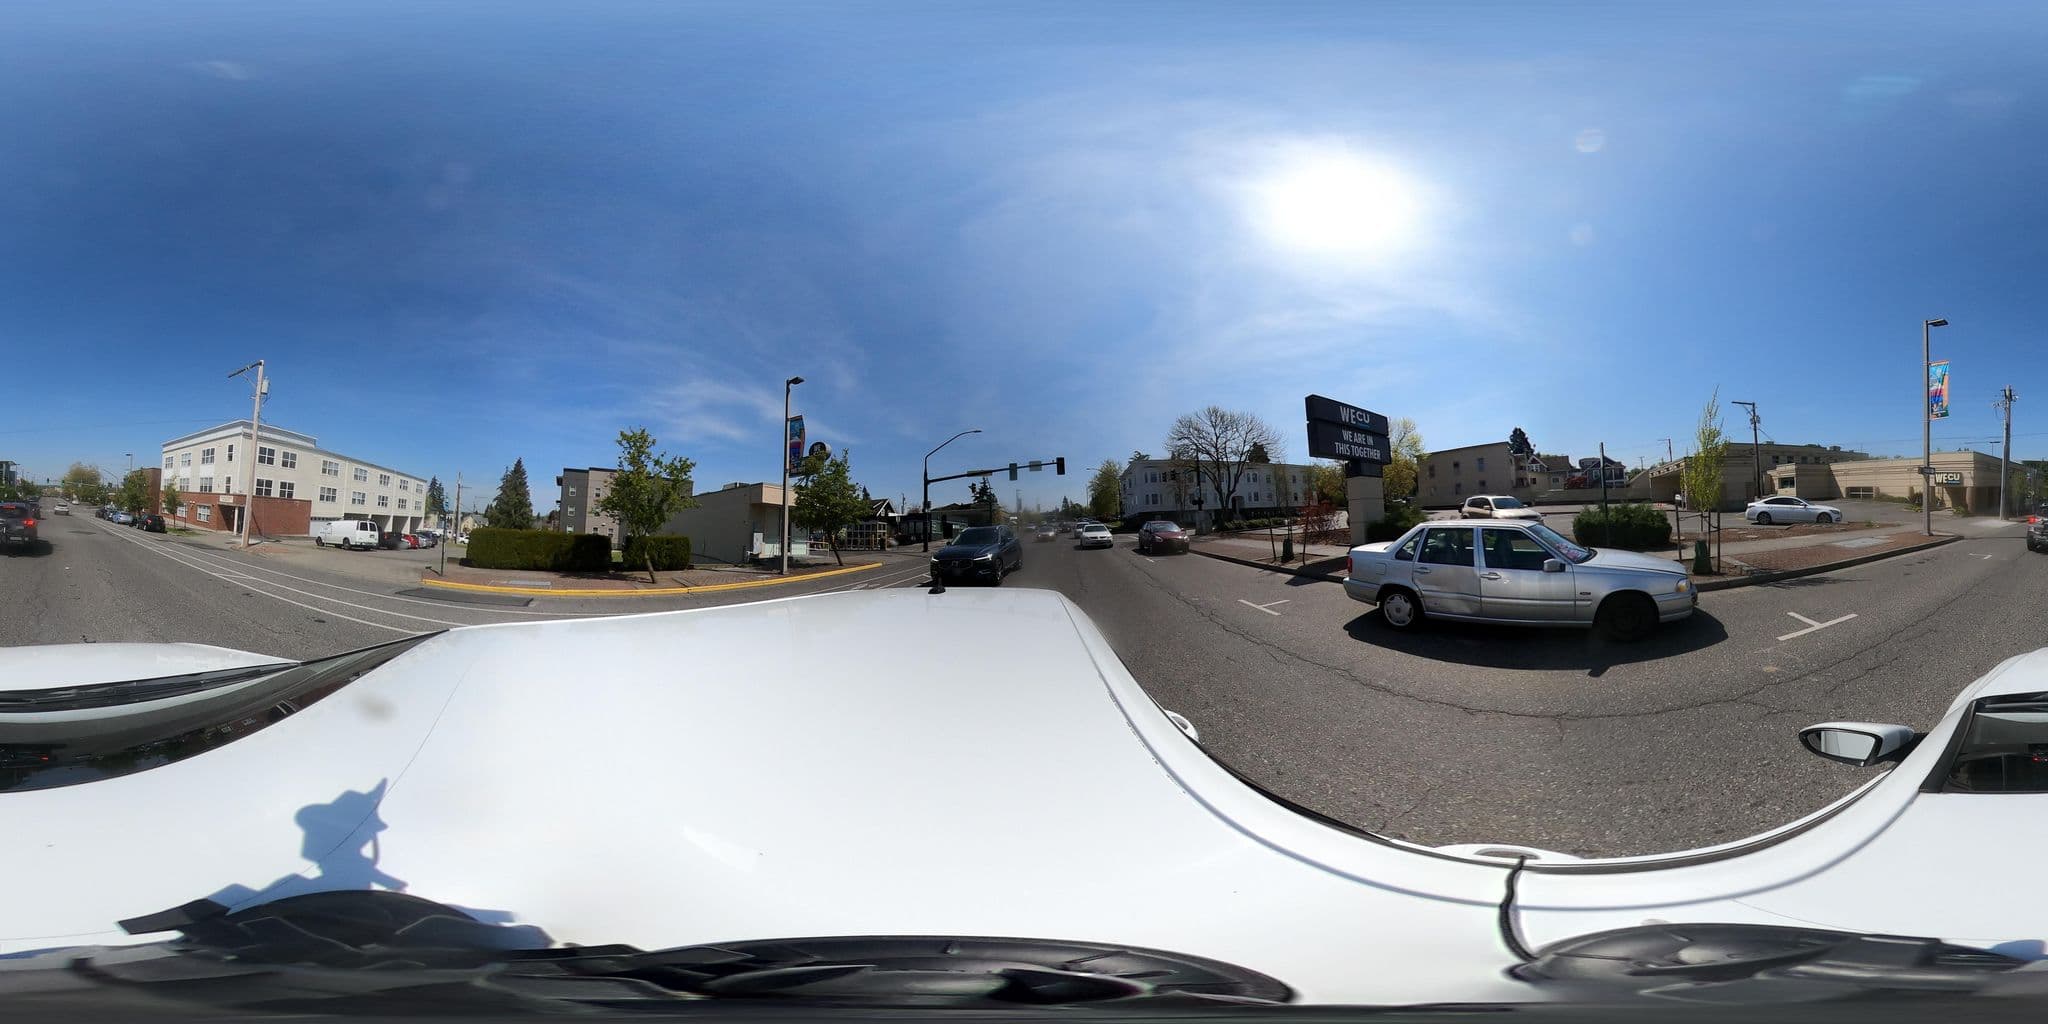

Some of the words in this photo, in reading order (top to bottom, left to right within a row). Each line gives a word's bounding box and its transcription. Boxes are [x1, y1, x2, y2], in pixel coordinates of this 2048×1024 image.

[1342, 429, 1353, 441] WE
[1354, 432, 1366, 444] ARE
[1367, 435, 1373, 445] IN
[1334, 442, 1350, 454] THIS
[1351, 445, 1380, 459] TOGETHER
